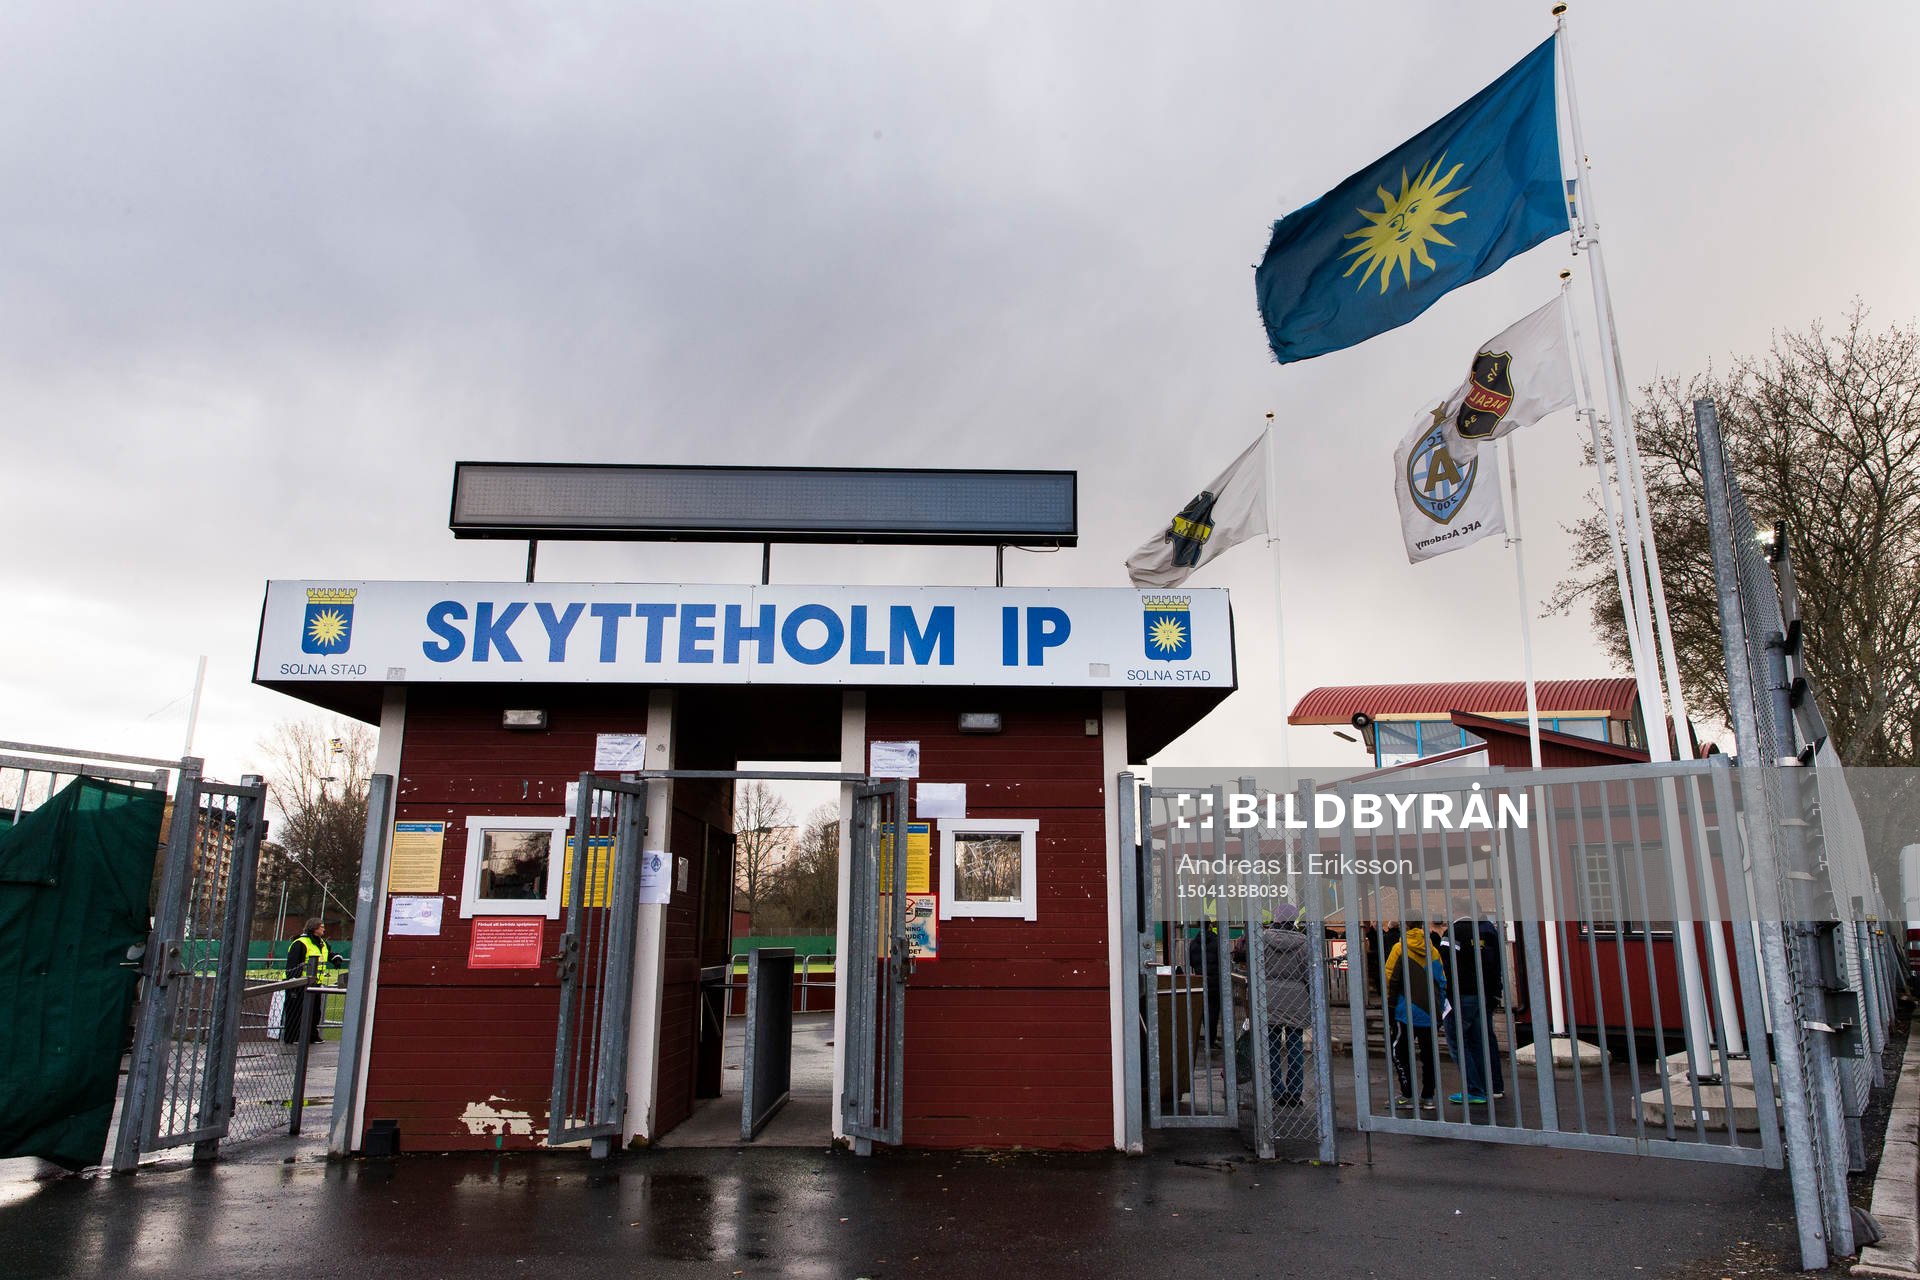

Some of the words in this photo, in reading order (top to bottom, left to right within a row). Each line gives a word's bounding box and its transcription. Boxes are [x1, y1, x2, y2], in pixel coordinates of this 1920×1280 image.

[422, 600, 956, 667] SKYTTEHOLM
[1002, 605, 1072, 667] IP
[280, 663, 327, 675] SOLNA
[330, 663, 367, 675] STAD
[1127, 669, 1173, 681] SOLNA
[1176, 670, 1211, 681] STAD
